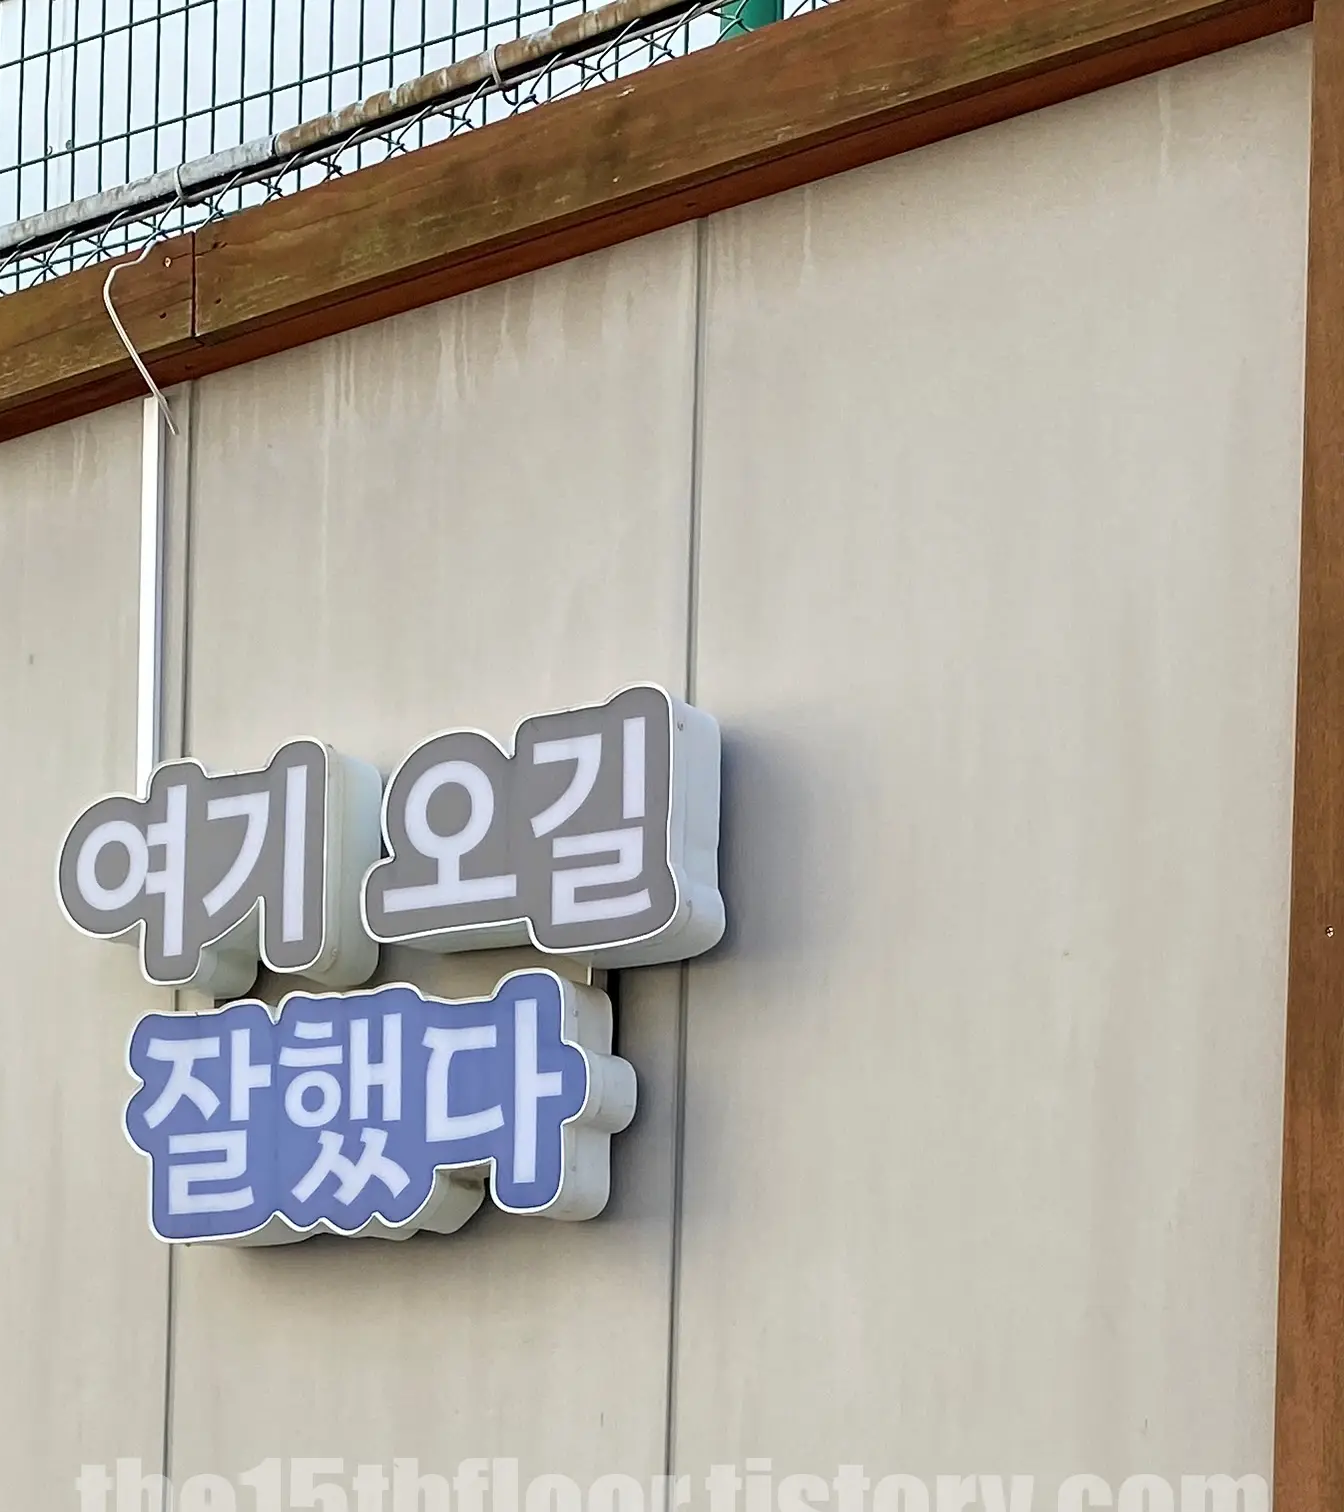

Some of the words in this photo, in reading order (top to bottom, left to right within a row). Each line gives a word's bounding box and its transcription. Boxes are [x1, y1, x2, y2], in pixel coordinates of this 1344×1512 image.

[76, 763, 308, 958] 여기
[383, 716, 653, 925] 오길
[142, 998, 563, 1217] 잘했다
